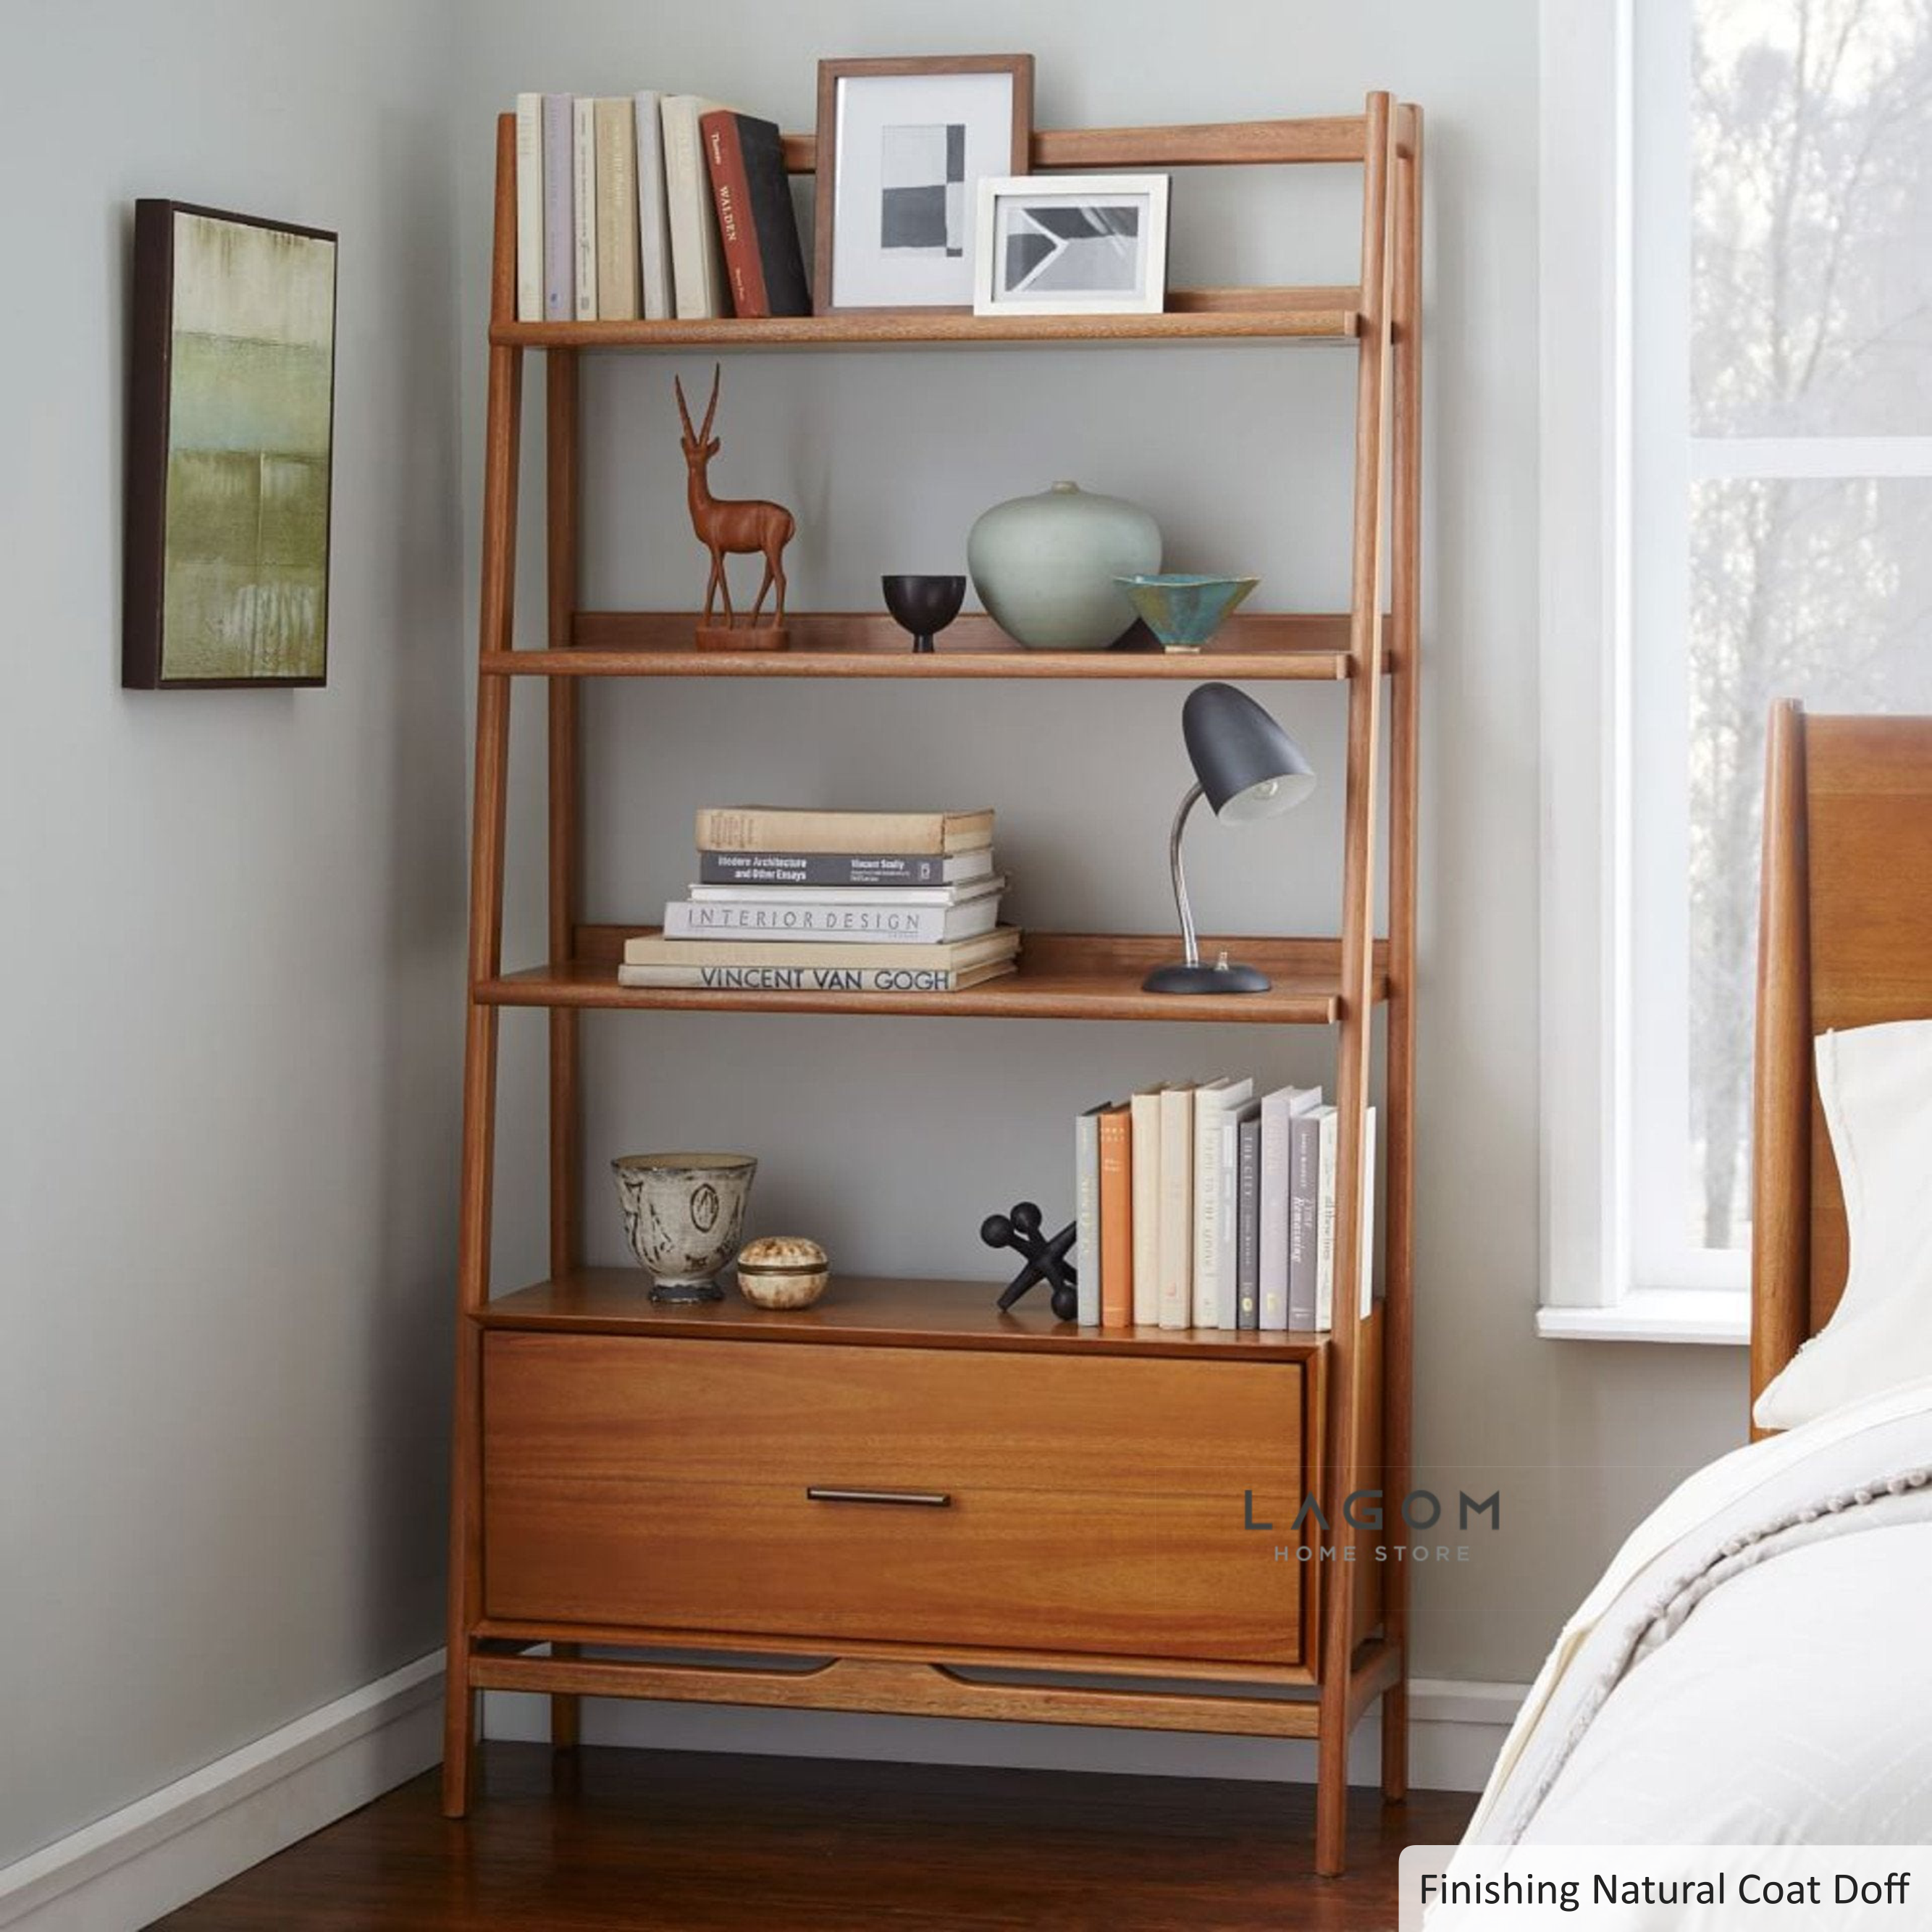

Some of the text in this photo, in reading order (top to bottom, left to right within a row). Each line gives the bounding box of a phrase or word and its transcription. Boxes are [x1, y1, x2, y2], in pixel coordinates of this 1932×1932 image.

[721, 185, 736, 241] WALDEN
[753, 857, 807, 868] Architecture
[734, 869, 807, 881] and Other Essays
[689, 909, 919, 931] INTERIOR DESIGN
[701, 968, 950, 991] VINCENT VAN GOGH
